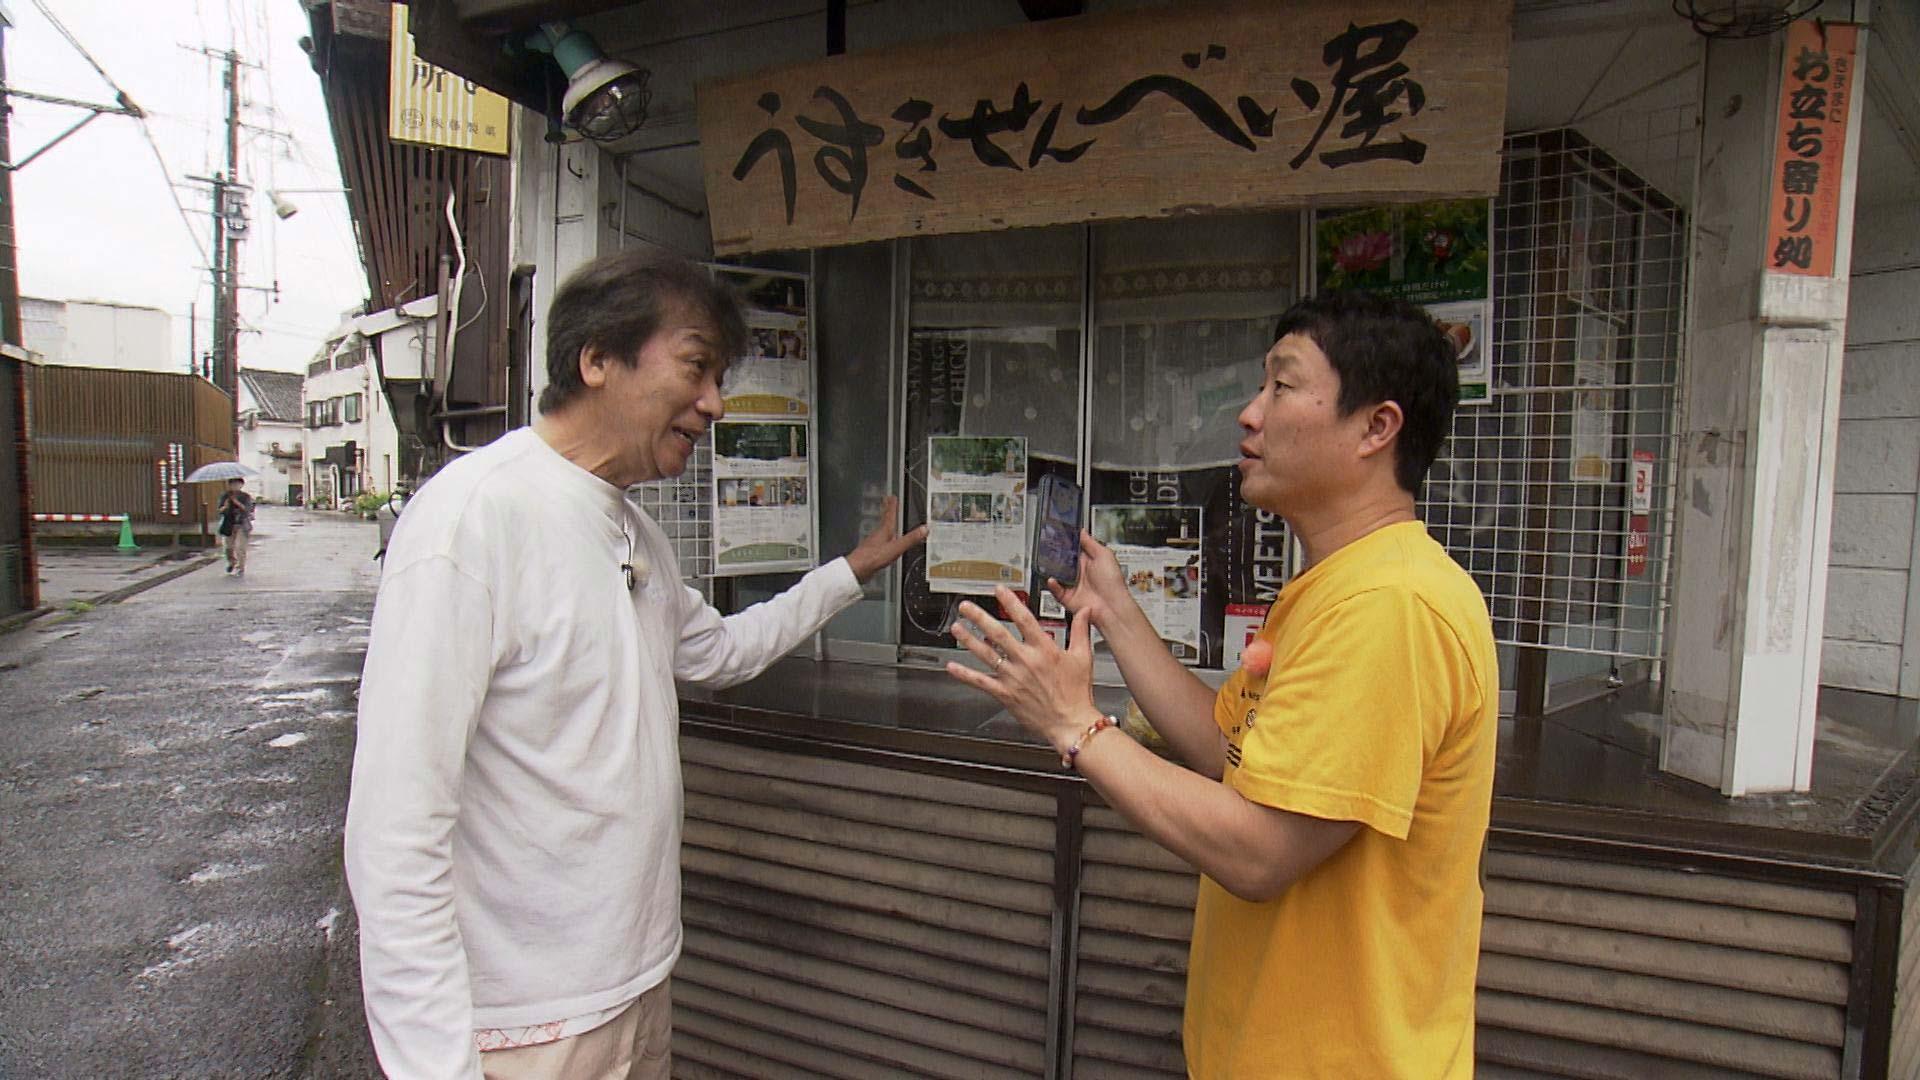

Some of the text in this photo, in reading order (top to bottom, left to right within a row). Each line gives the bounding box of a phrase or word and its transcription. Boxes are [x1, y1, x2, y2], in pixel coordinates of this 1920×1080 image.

[732, 19, 1429, 225] うすきせんべい屋
[1773, 45, 1831, 270] お立ち寄り処
